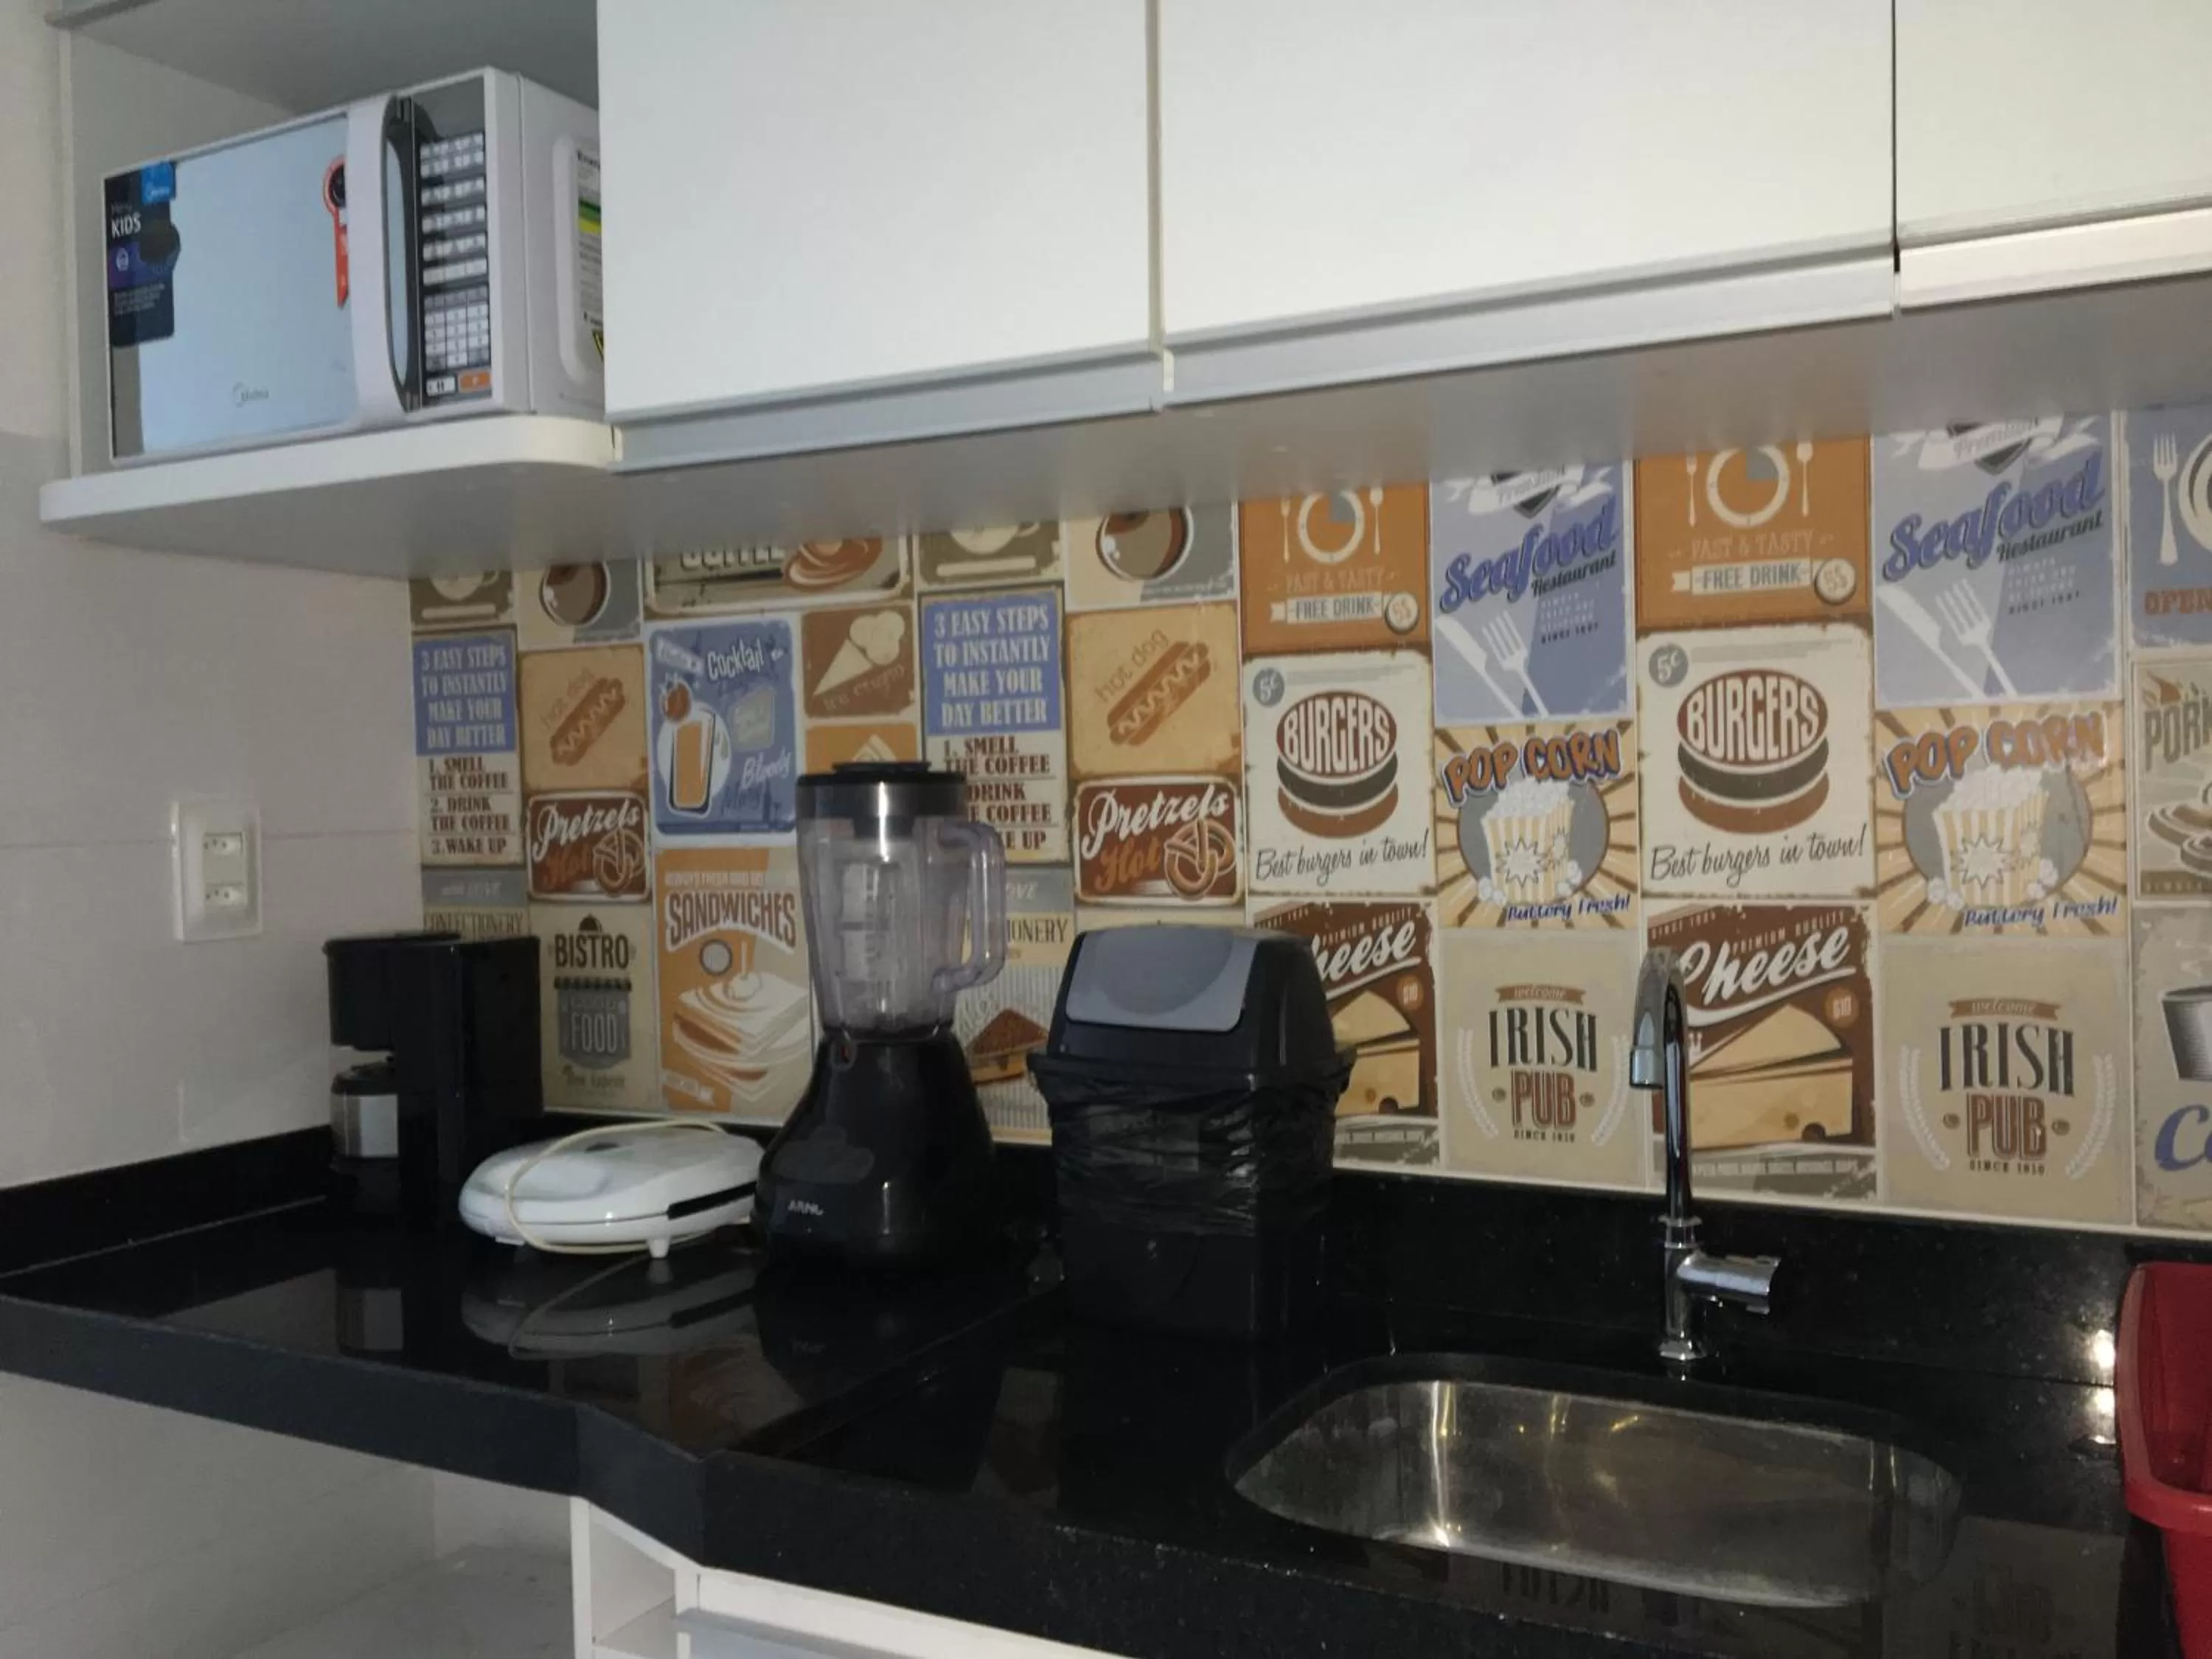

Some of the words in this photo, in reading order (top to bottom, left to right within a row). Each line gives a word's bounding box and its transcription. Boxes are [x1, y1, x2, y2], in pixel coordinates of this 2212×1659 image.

[111, 212, 141, 238] KIDS
[1882, 450, 2105, 582] Seafood
[1439, 493, 1619, 613] Seafood
[1703, 567, 1743, 590] FREE
[1750, 563, 1802, 586] DRINK
[934, 612, 945, 639] 3
[951, 608, 991, 638] EASY
[996, 604, 1048, 634] STEPS
[1295, 600, 1327, 620] FREE
[1333, 594, 1374, 616] DRINK
[707, 637, 765, 681] Cocktail
[933, 641, 957, 669] TO
[963, 635, 1051, 667] INSTANTLY
[1131, 629, 1169, 667] dog
[944, 670, 990, 698] MAKE
[996, 667, 1043, 695] YOUR
[942, 703, 974, 728] DAY
[981, 698, 1047, 726] BETTER
[1284, 695, 1390, 773] BURGERS
[1686, 674, 1819, 762] BURGERS
[945, 757, 978, 776] THE
[984, 754, 1050, 774] COFFEE
[964, 735, 1019, 756] SMELL
[1442, 740, 1519, 805] POP
[1520, 727, 1621, 782] CORN
[1885, 724, 1980, 798] POP
[1983, 710, 2107, 771] CORN
[967, 782, 1026, 802] DRINK
[986, 804, 1051, 823] COFFEE
[532, 798, 641, 863] Pretzels
[1022, 831, 1046, 849] UP
[1081, 783, 1229, 860] Pretzels
[1256, 848, 1297, 880] Best
[1298, 844, 1352, 886] burgers
[1359, 839, 1378, 866] in
[1383, 827, 1429, 863] town!
[1651, 846, 1704, 880] Best
[1702, 841, 1770, 888] burgers
[1780, 835, 1804, 865] in
[1809, 822, 1868, 862] town!
[667, 891, 796, 947] SANDWICHES
[554, 933, 629, 970] BISTRO
[1312, 921, 1416, 982] heese
[571, 1012, 617, 1054] FOOD
[1488, 1005, 1598, 1073] IRISH
[1938, 1021, 2075, 1098] IRISH
[1511, 1069, 1577, 1130] PUB
[1966, 1091, 2048, 1162] PUB
